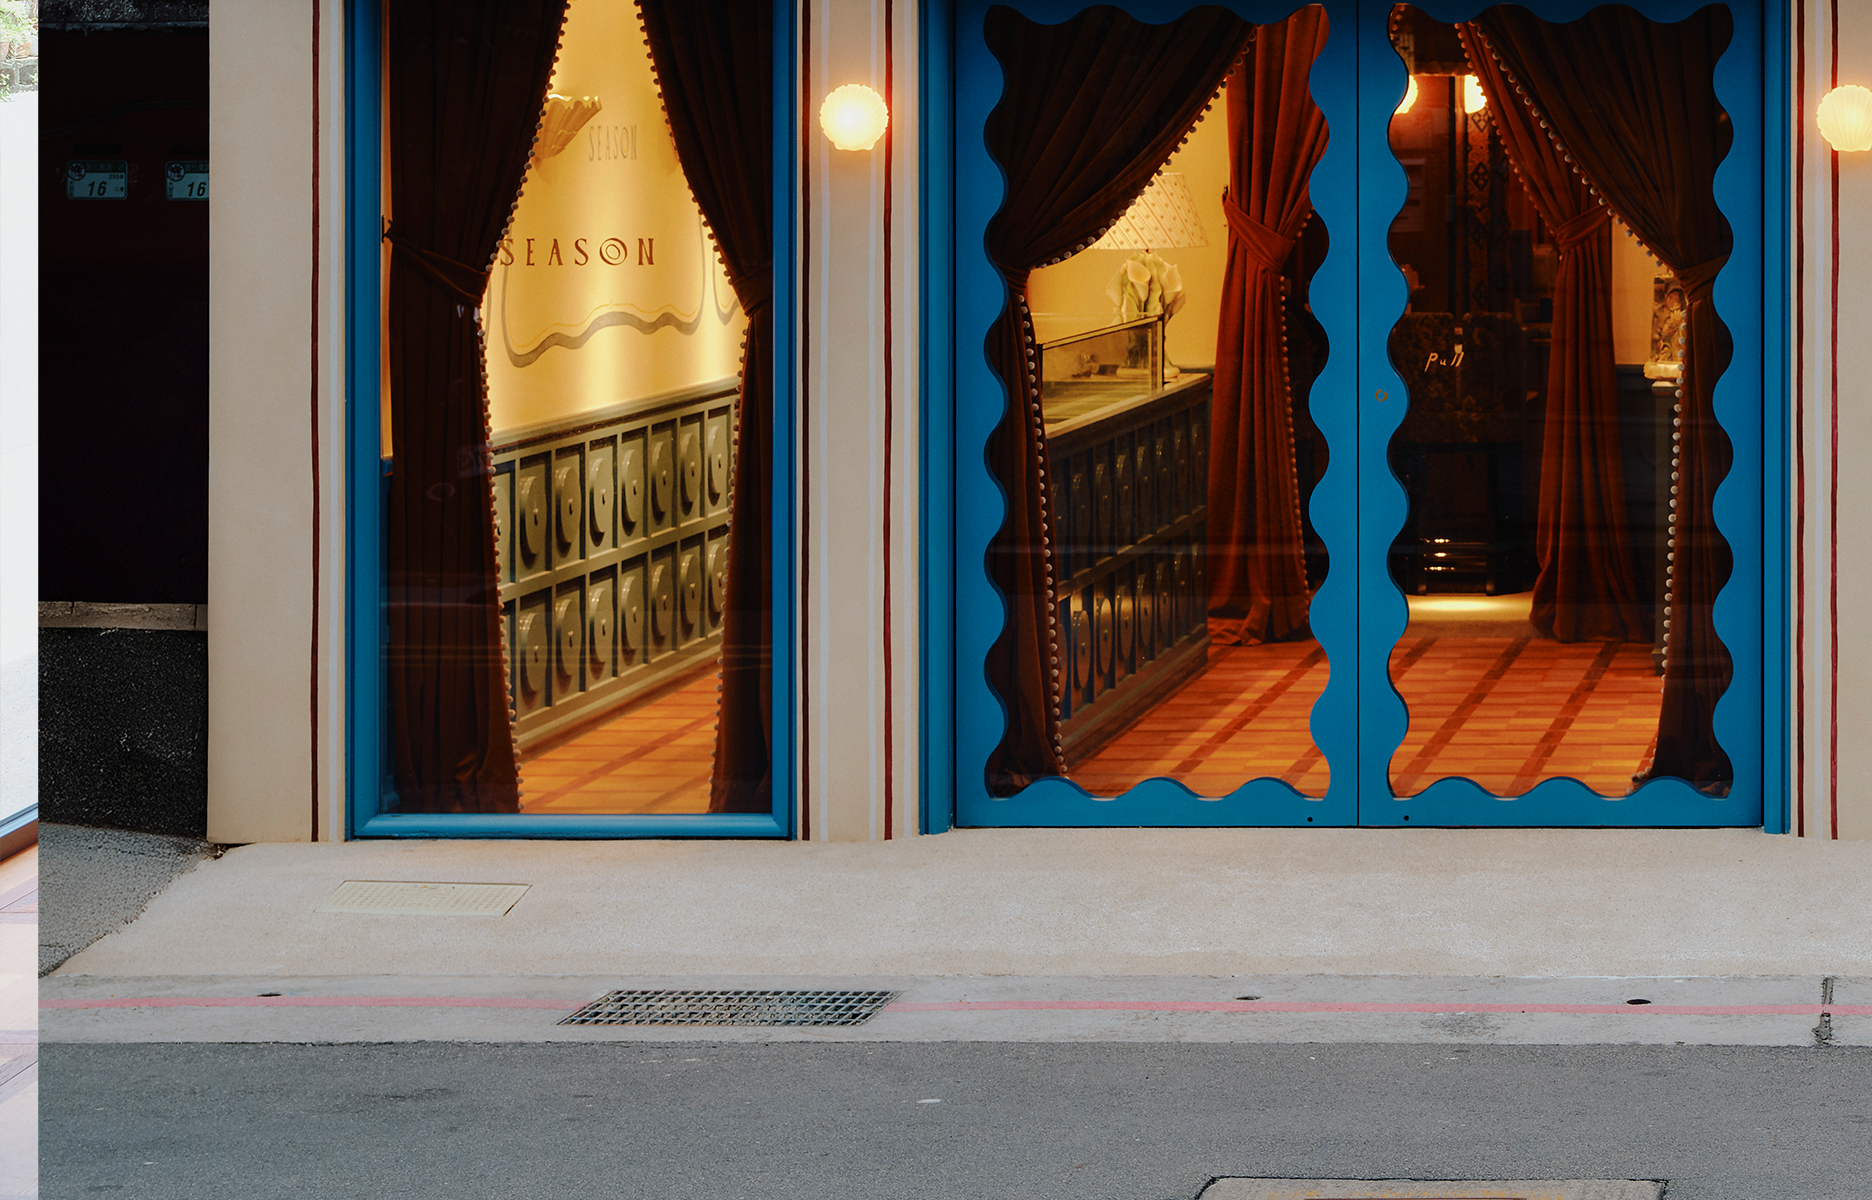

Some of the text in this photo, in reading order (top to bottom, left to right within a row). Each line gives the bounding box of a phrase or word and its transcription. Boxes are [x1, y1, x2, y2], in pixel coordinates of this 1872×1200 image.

[588, 125, 637, 162] SEASON
[88, 181, 107, 196] 16
[187, 181, 207, 197] 16
[500, 237, 655, 266] SEASON
